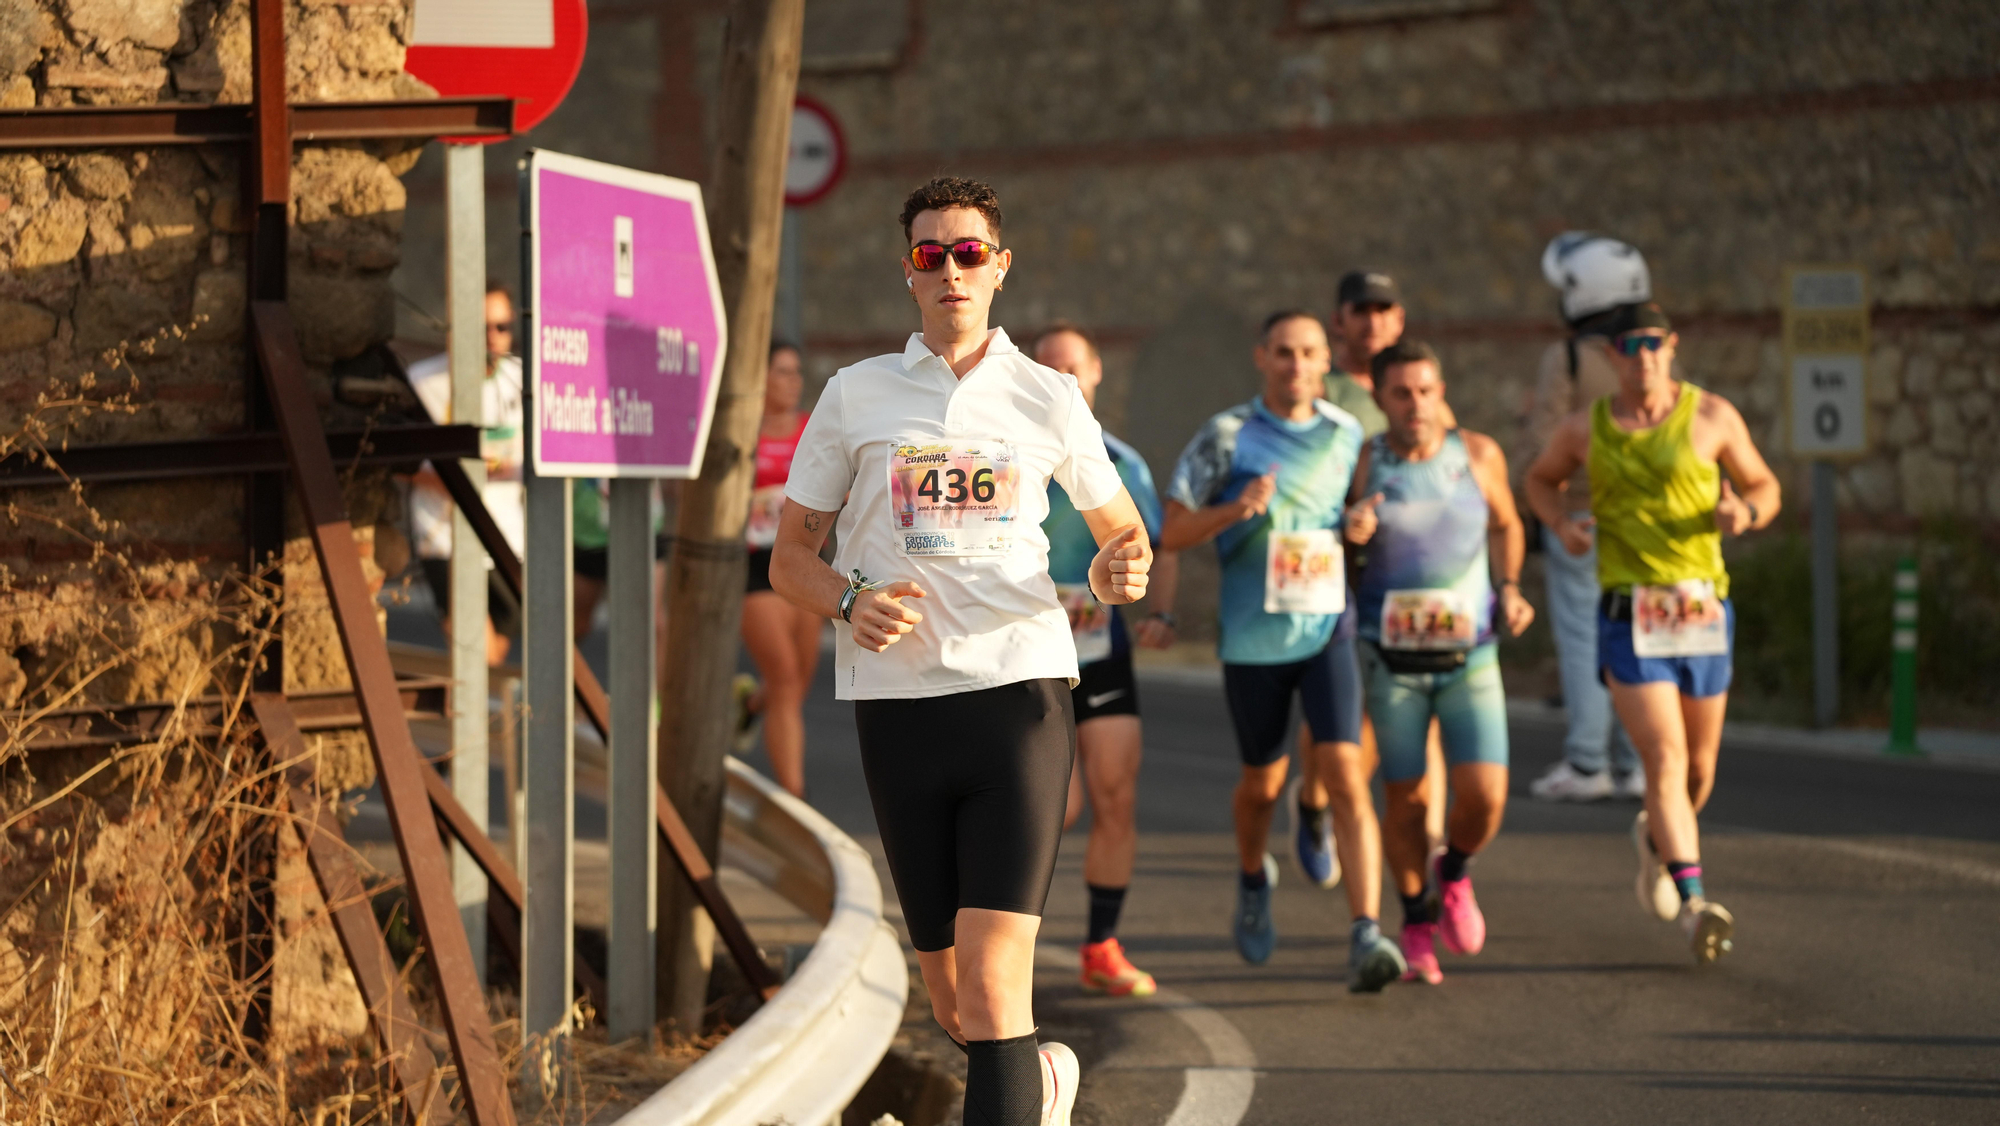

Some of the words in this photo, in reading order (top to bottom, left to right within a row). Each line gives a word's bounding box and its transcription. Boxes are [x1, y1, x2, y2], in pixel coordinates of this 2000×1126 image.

[543, 325, 588, 367] acceso
[656, 326, 684, 374] 500
[686, 340, 699, 376] m
[541, 381, 597, 435] Madinat
[1813, 402, 1841, 442] 0
[918, 468, 996, 503] 436
[905, 535, 946, 543] carreras
[906, 540, 955, 550] populares
